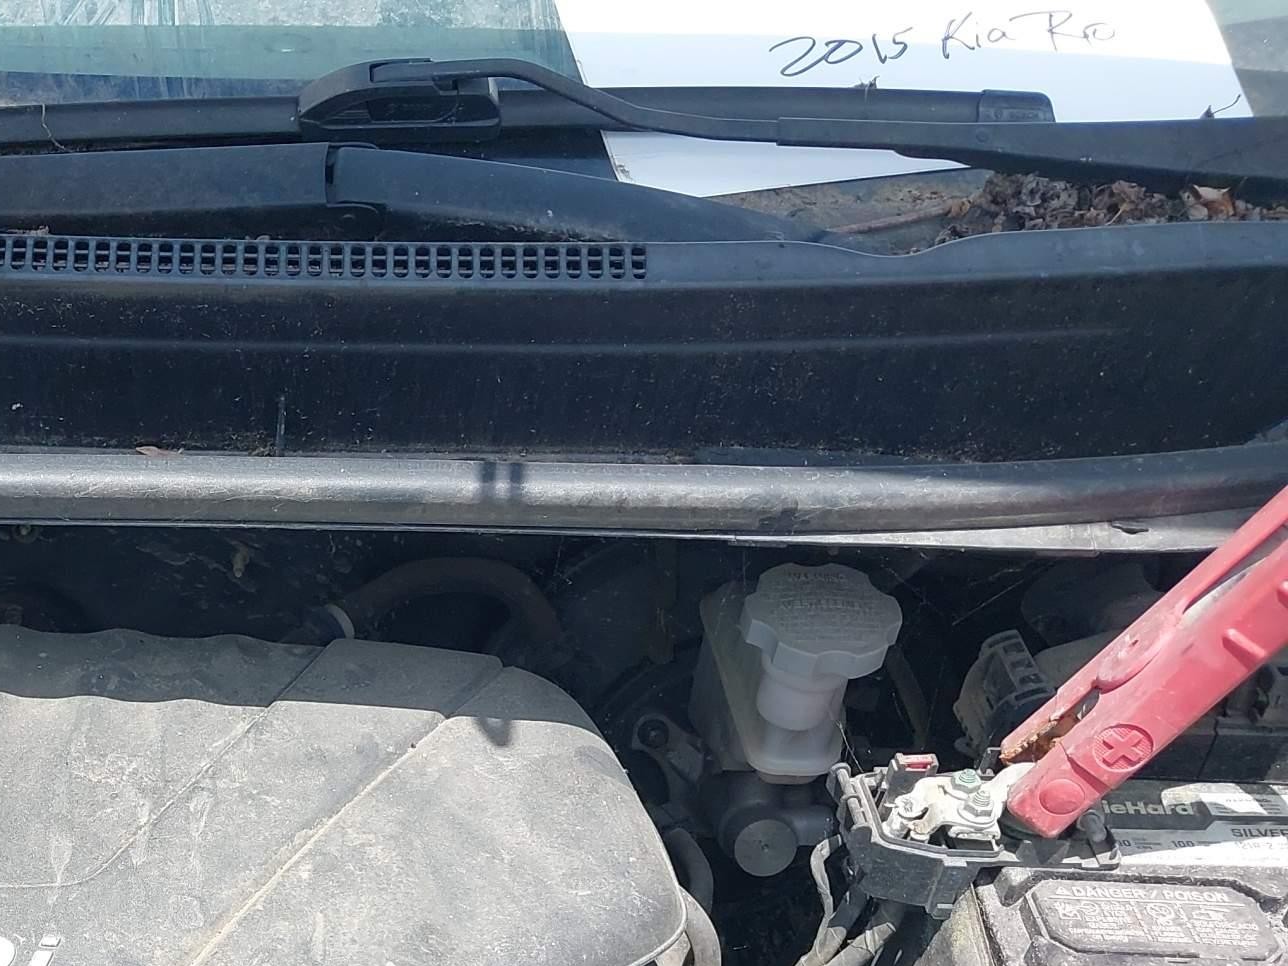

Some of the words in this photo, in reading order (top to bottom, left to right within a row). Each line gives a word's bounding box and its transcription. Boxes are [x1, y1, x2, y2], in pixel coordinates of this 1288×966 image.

[768, 26, 913, 77] 2015
[941, 11, 1017, 59] Kia
[1101, 799, 1194, 816] ieHard
[1071, 885, 1146, 899] DANGER
[1162, 888, 1229, 902] POISON
